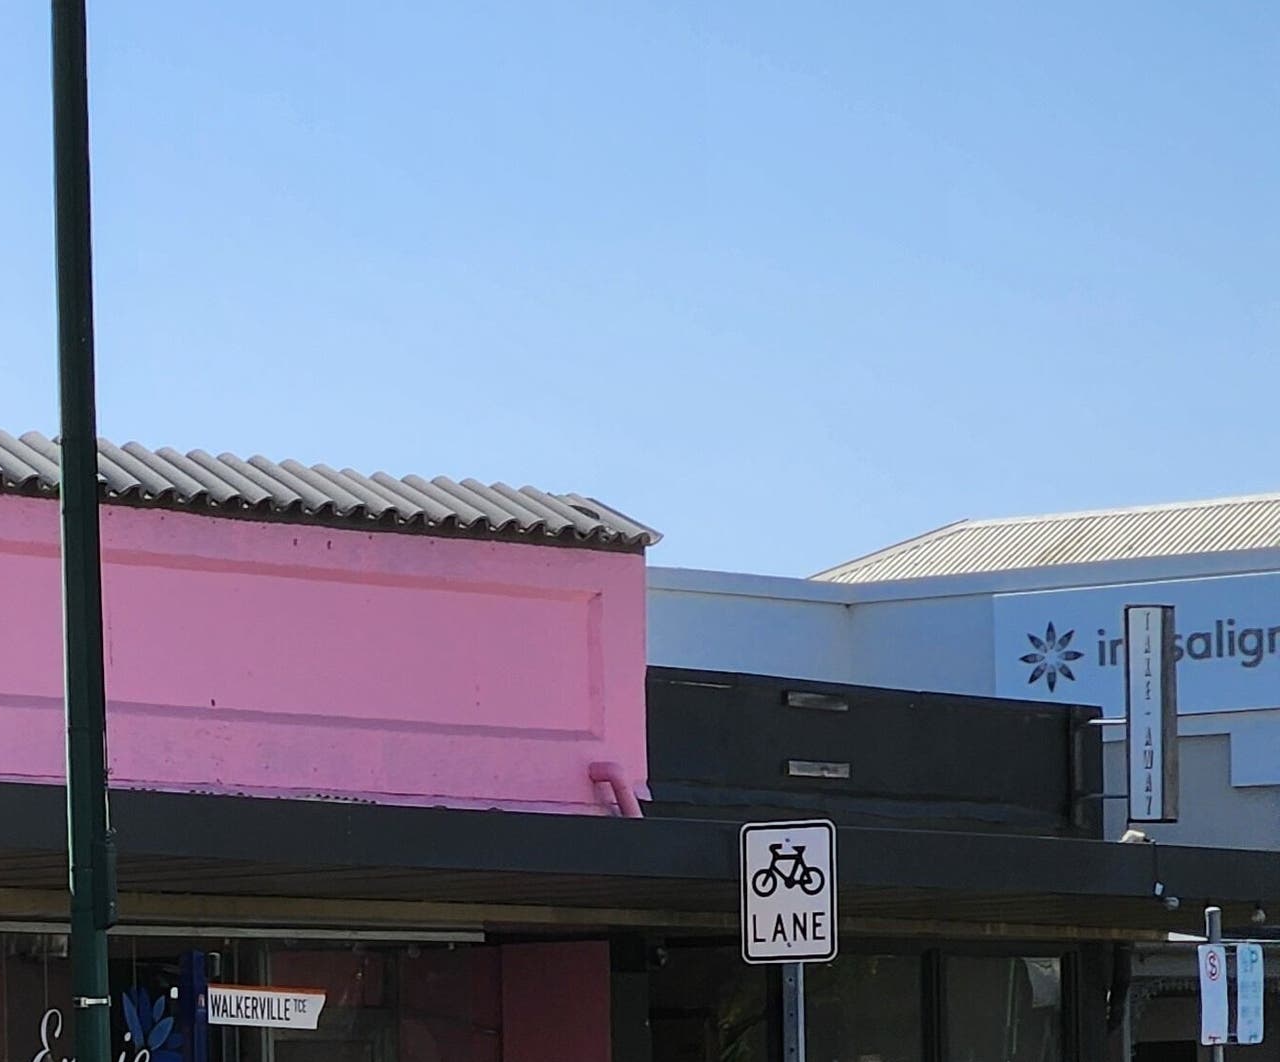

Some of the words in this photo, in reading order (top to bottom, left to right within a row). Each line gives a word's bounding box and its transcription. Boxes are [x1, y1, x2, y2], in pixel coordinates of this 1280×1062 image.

[752, 911, 826, 943] LANE
[210, 994, 291, 1021] WALKERVILLE
[293, 998, 307, 1013] TCE
